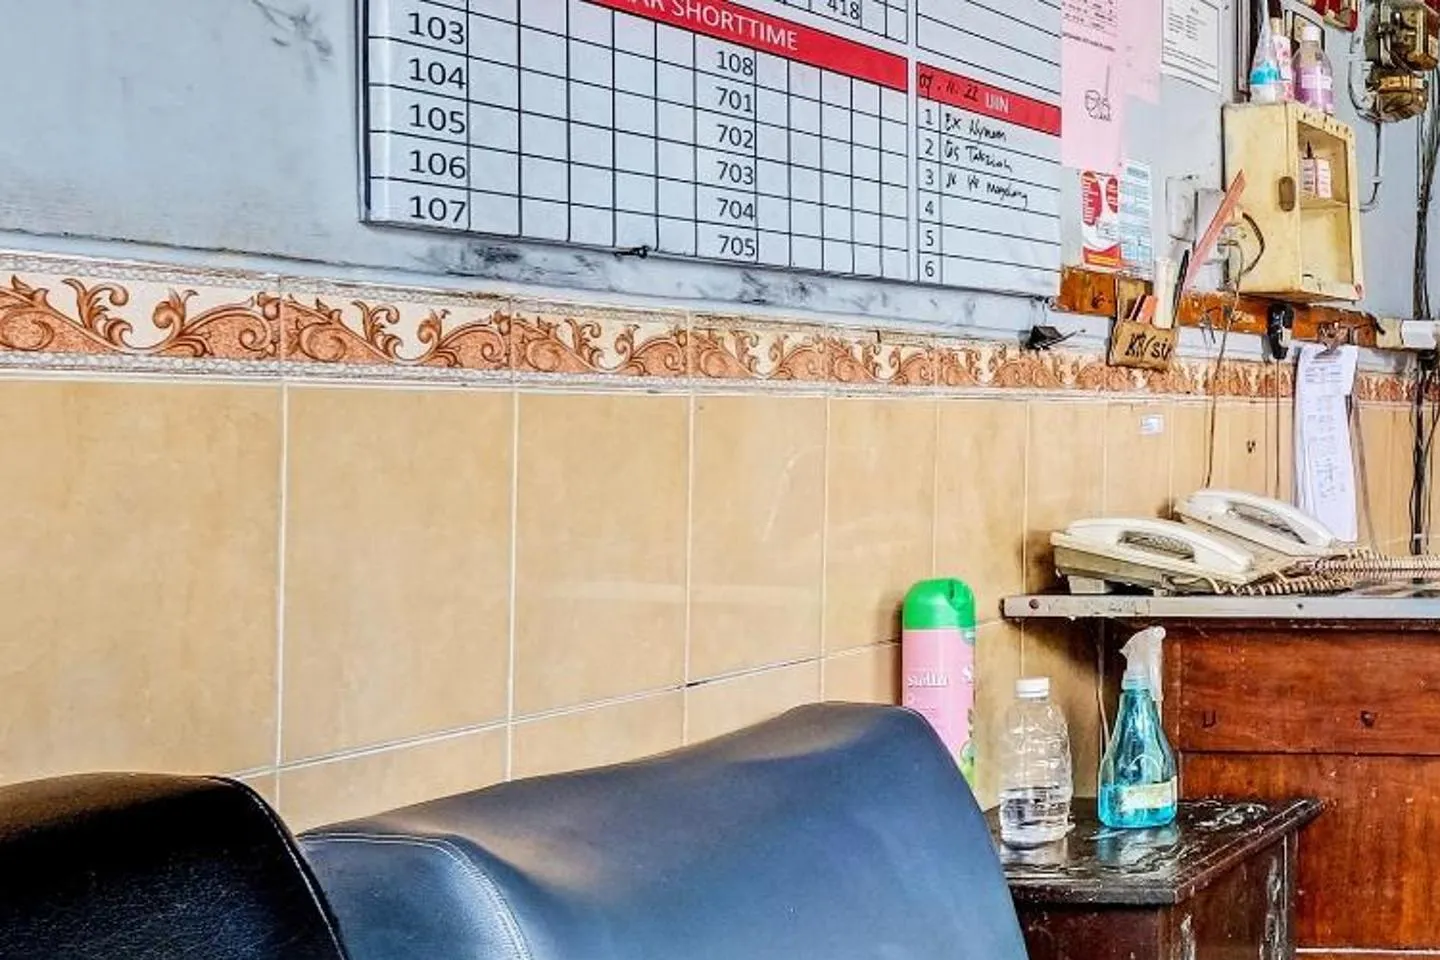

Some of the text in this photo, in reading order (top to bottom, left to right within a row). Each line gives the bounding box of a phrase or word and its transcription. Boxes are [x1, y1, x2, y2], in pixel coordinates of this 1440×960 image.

[827, 0, 860, 19] 418
[408, 13, 464, 45] 103
[672, 0, 798, 50] SHORTTIME
[409, 58, 467, 89] 104
[716, 51, 753, 76] 108
[716, 87, 753, 112] 701
[409, 104, 467, 134] 105
[925, 108, 934, 126] 1
[716, 124, 753, 148] 702
[924, 137, 934, 156] 2
[409, 150, 467, 180] 106
[716, 161, 754, 185] 703
[925, 168, 934, 186] 3
[409, 196, 467, 223] 107
[717, 198, 756, 220] 704
[924, 200, 934, 215] 4
[717, 235, 756, 257] 705
[925, 229, 934, 247] 5
[924, 261, 934, 278] 6
